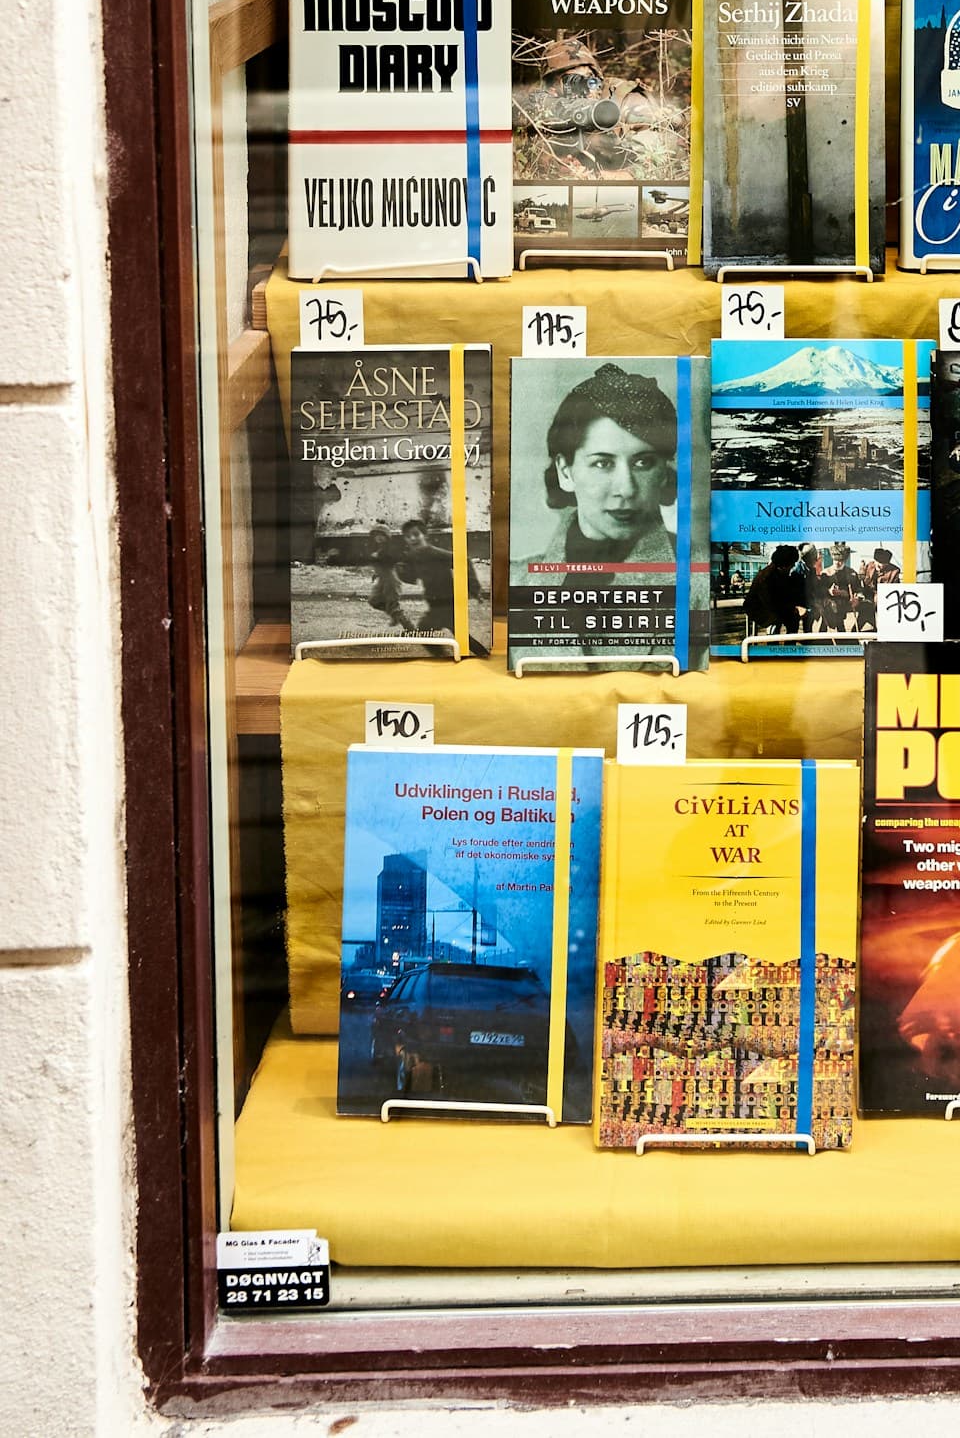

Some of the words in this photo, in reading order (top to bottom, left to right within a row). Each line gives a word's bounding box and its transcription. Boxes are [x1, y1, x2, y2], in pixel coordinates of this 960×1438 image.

[718, 1, 780, 30] Serhij
[338, 44, 459, 93] DIARY
[751, 81, 785, 92] edition
[786, 81, 838, 95] suhrkamp
[786, 97, 801, 108] SV
[304, 176, 373, 231] VELJKO
[344, 359, 438, 397] ÅSNE
[301, 438, 377, 468] Englen
[382, 438, 389, 461] i
[756, 501, 891, 519] Nordkaukasus
[533, 590, 664, 604] DEPORTERET
[533, 615, 570, 629] TIL
[395, 783, 492, 802] Udviklingen
[421, 805, 468, 821] Polen
[474, 810, 495, 824] og
[724, 823, 749, 838] AT
[903, 839, 935, 853] Two
[710, 846, 763, 864] WAR
[917, 858, 955, 872] other
[226, 1271, 323, 1287] DØGNVAGT
[227, 1291, 247, 1303] 28
[252, 1290, 271, 1302] 71
[278, 1289, 298, 1301] 23
[304, 1287, 323, 1300] 15
